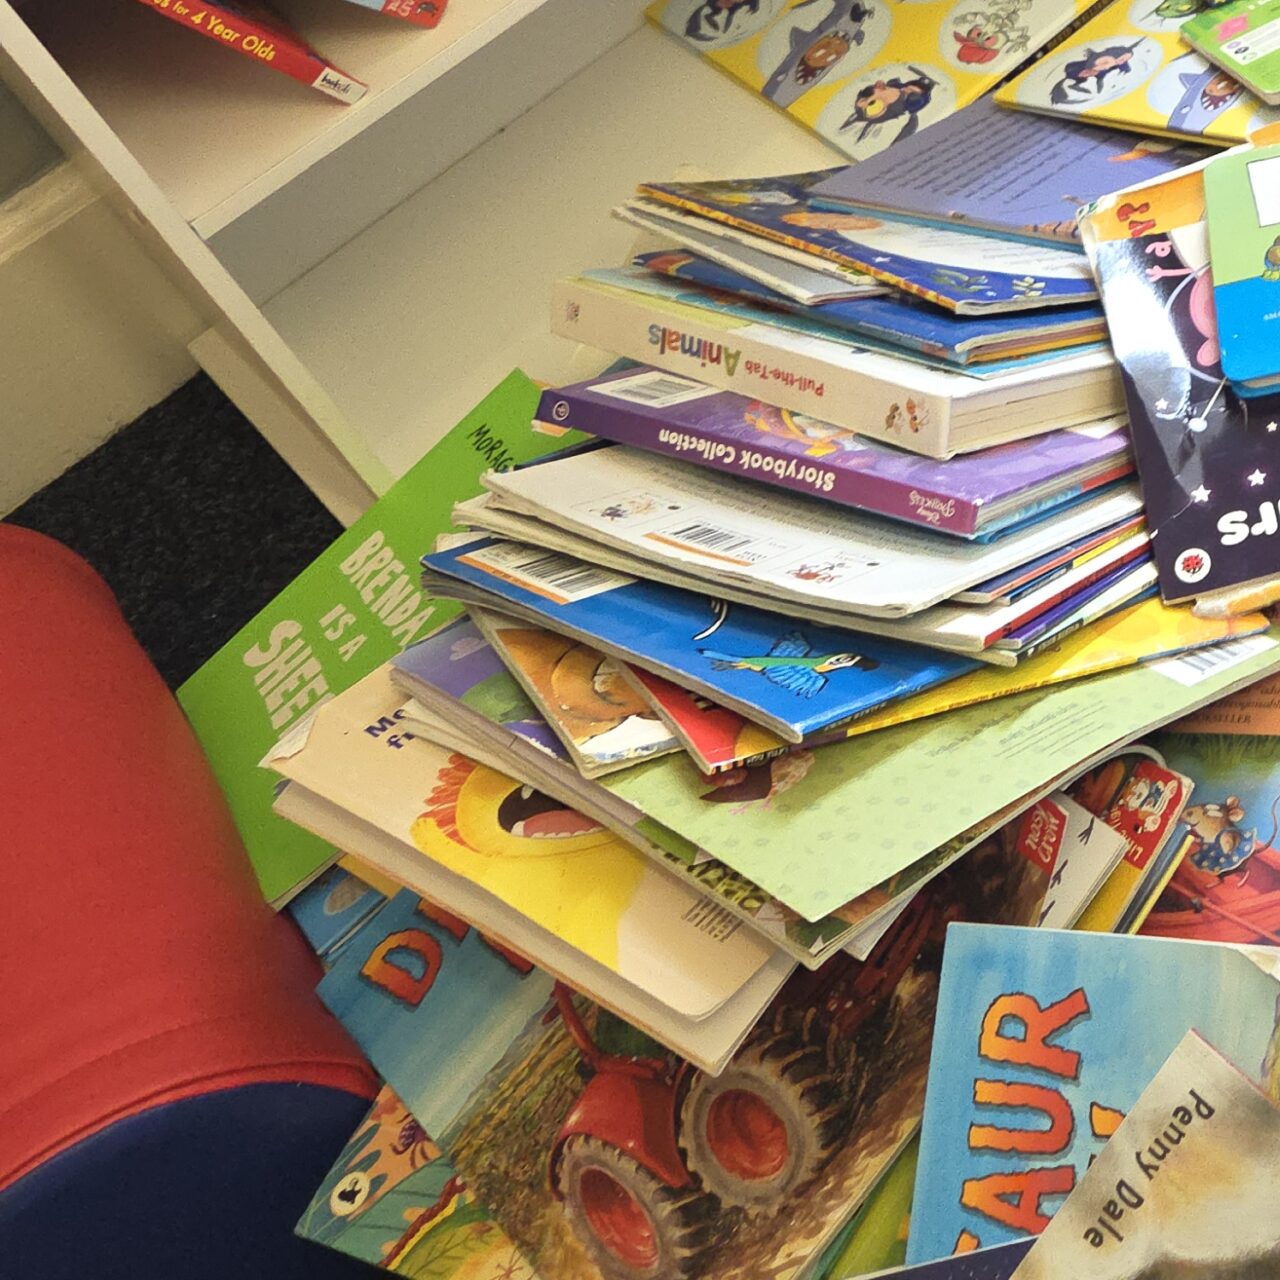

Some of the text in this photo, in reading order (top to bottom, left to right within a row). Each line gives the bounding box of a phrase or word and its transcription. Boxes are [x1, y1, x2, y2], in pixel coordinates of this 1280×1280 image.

[172, 0, 190, 18] for
[190, 10, 206, 26] 4
[206, 16, 242, 45] Year
[242, 35, 276, 63] Olds
[648, 323, 742, 377] Animals
[744, 359, 825, 397] Pull-the-Tab
[659, 428, 836, 492] Storybook Collection
[338, 530, 437, 647] BRENDA
[318, 603, 369, 663] IS A
[1024, 803, 1049, 851] nosy
[1036, 816, 1060, 864] crow
[953, 986, 1094, 1257] AUR
[1083, 1086, 1218, 1252] Penny Dale
